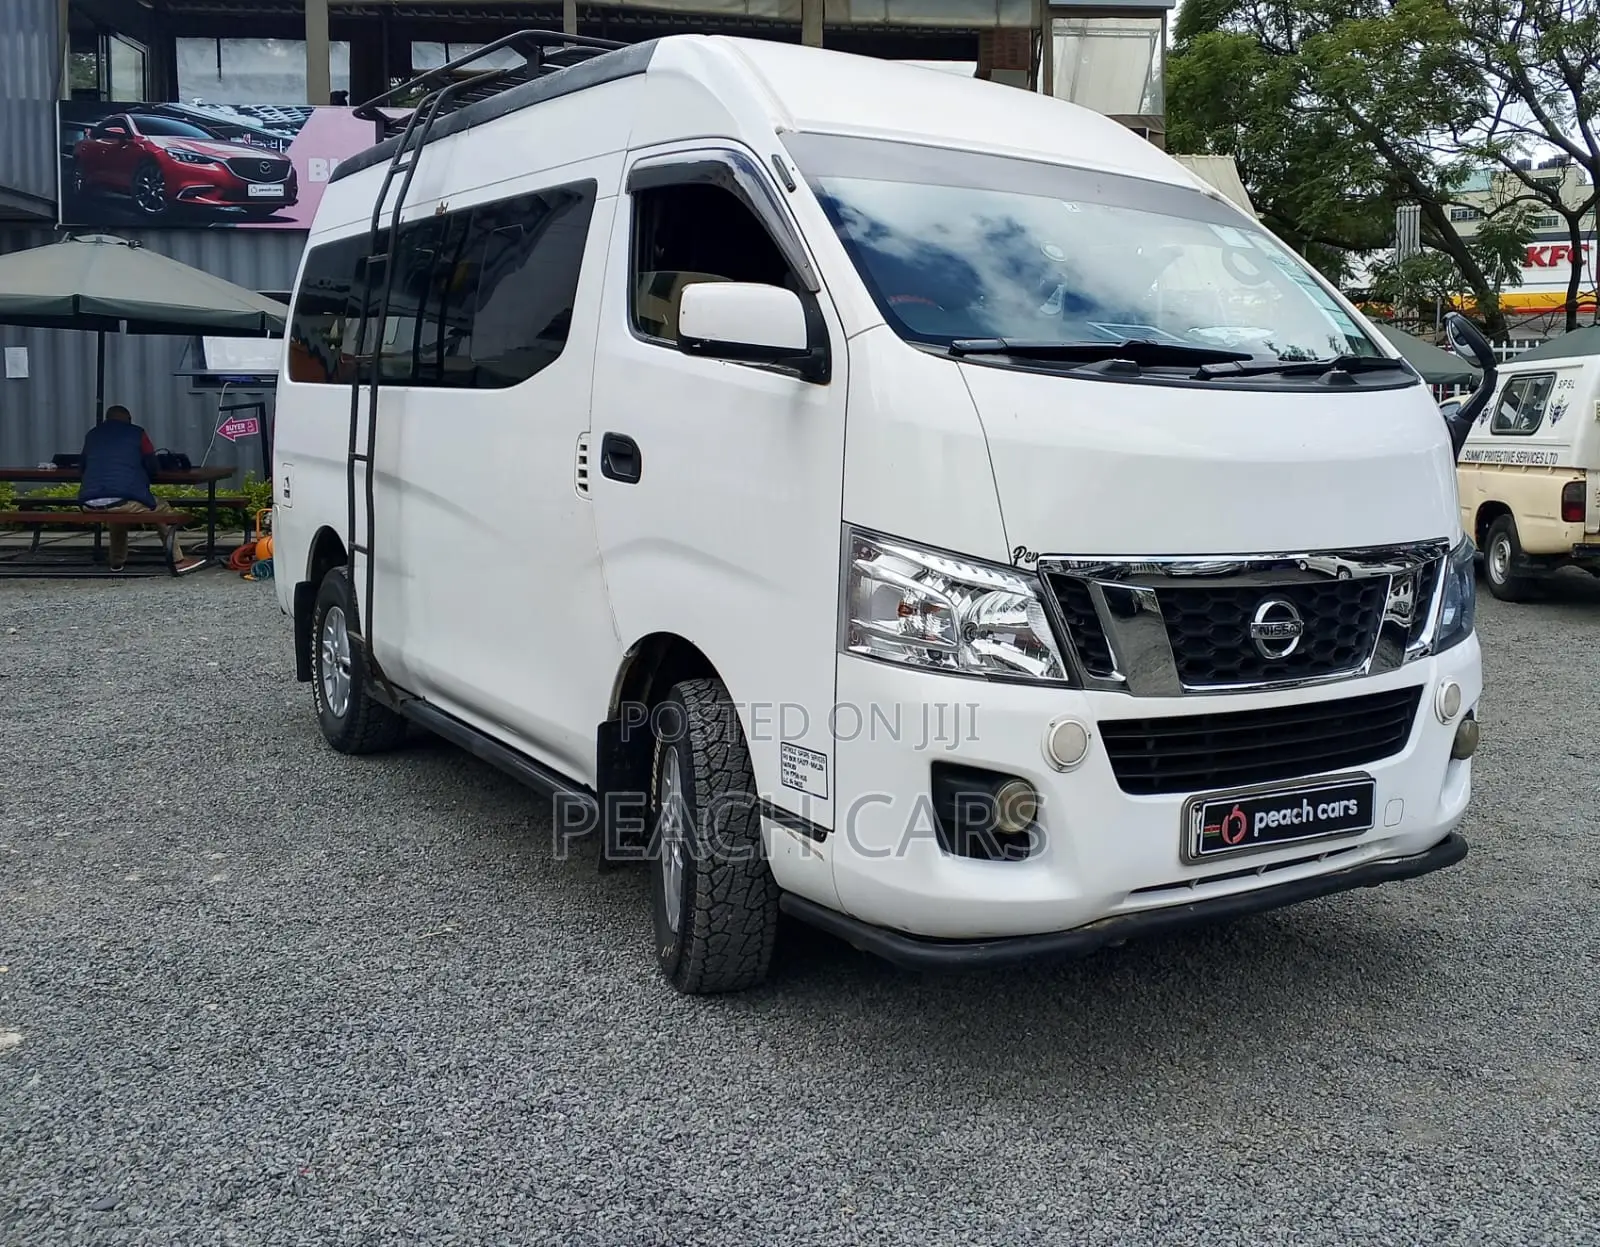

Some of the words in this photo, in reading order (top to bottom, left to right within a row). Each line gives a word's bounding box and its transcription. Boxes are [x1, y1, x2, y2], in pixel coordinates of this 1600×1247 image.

[225, 423, 246, 431] BUYER
[1464, 449, 1484, 461] SUMMIT
[1483, 450, 1515, 463] PROTECTIVE
[1515, 450, 1544, 464] SERVICES
[1545, 452, 1559, 465] LTD
[1256, 622, 1302, 635] NISSAN
[1253, 798, 1315, 838] peach
[1317, 799, 1358, 820] cars
